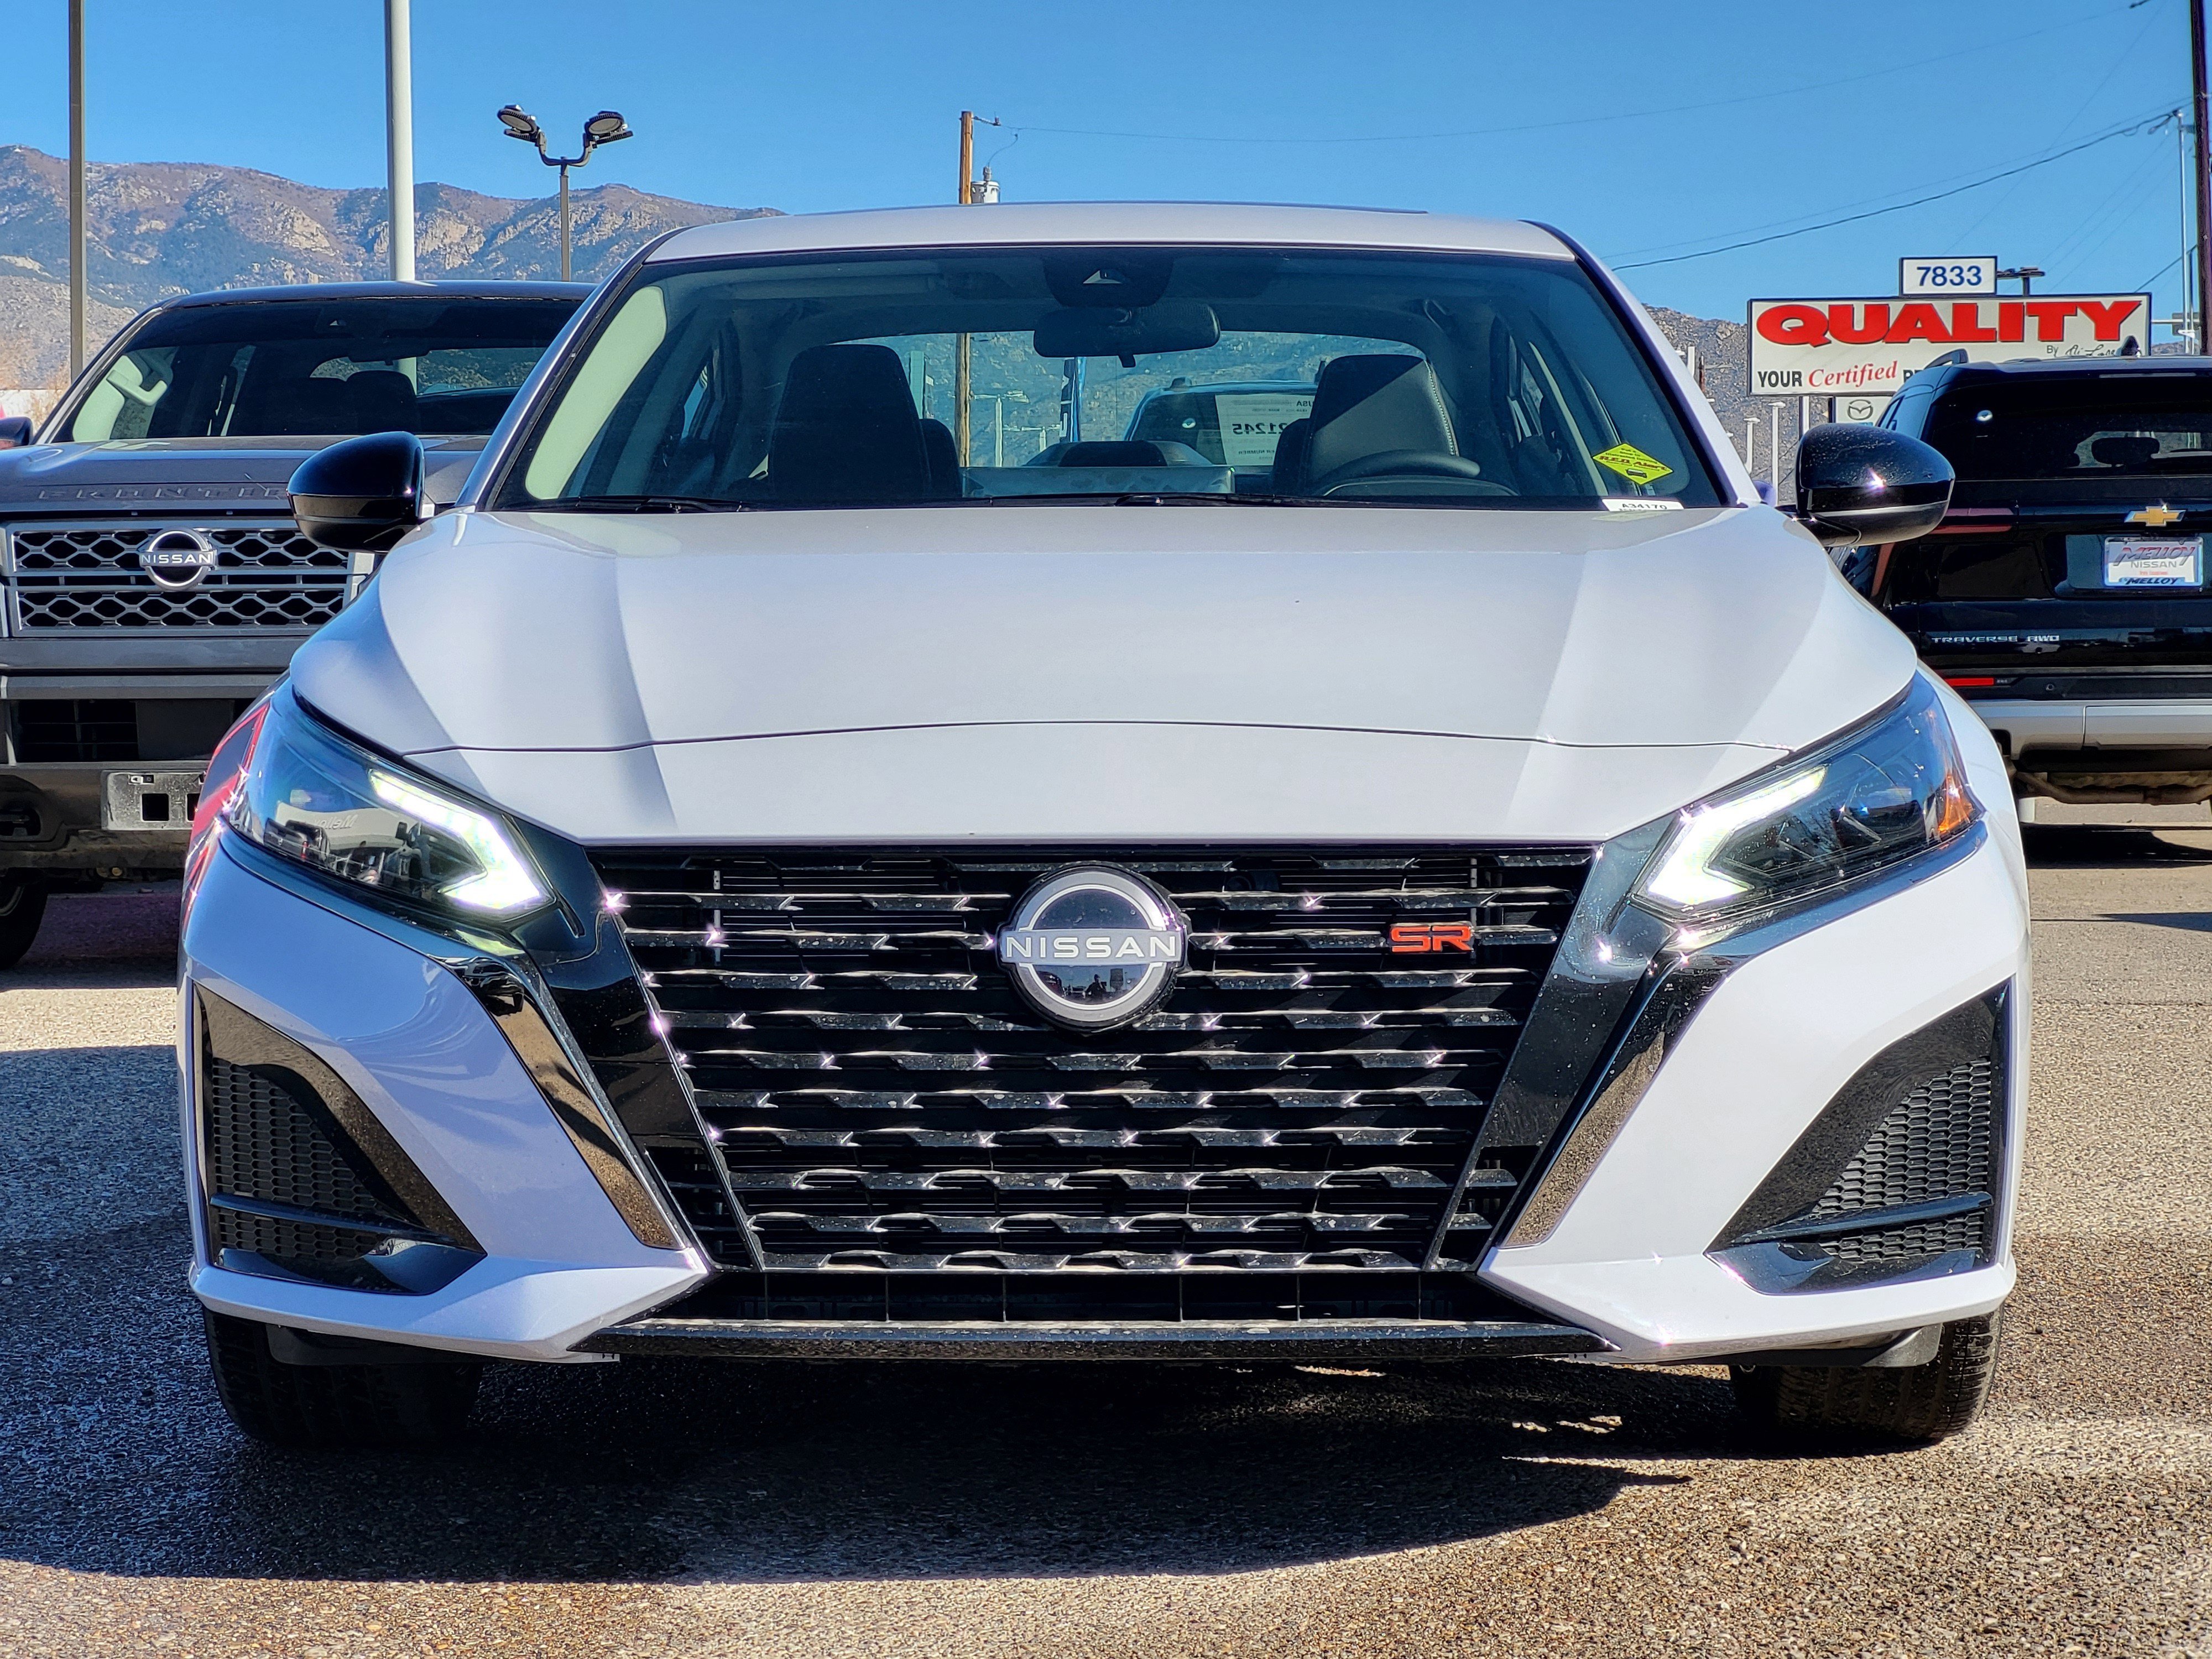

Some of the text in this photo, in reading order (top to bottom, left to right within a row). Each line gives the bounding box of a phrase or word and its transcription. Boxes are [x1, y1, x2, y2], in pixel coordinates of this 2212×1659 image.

[1916, 265, 1983, 287] 7833
[1756, 300, 2142, 348] QUALITY
[2046, 345, 2059, 357] By
[1757, 370, 1803, 387] YOUR
[1808, 360, 1898, 388] Certified
[38, 487, 288, 499] FRONTIE
[141, 554, 212, 565] NISSAN
[1006, 936, 1176, 958] NISSAN
[1390, 925, 1473, 953] SR
